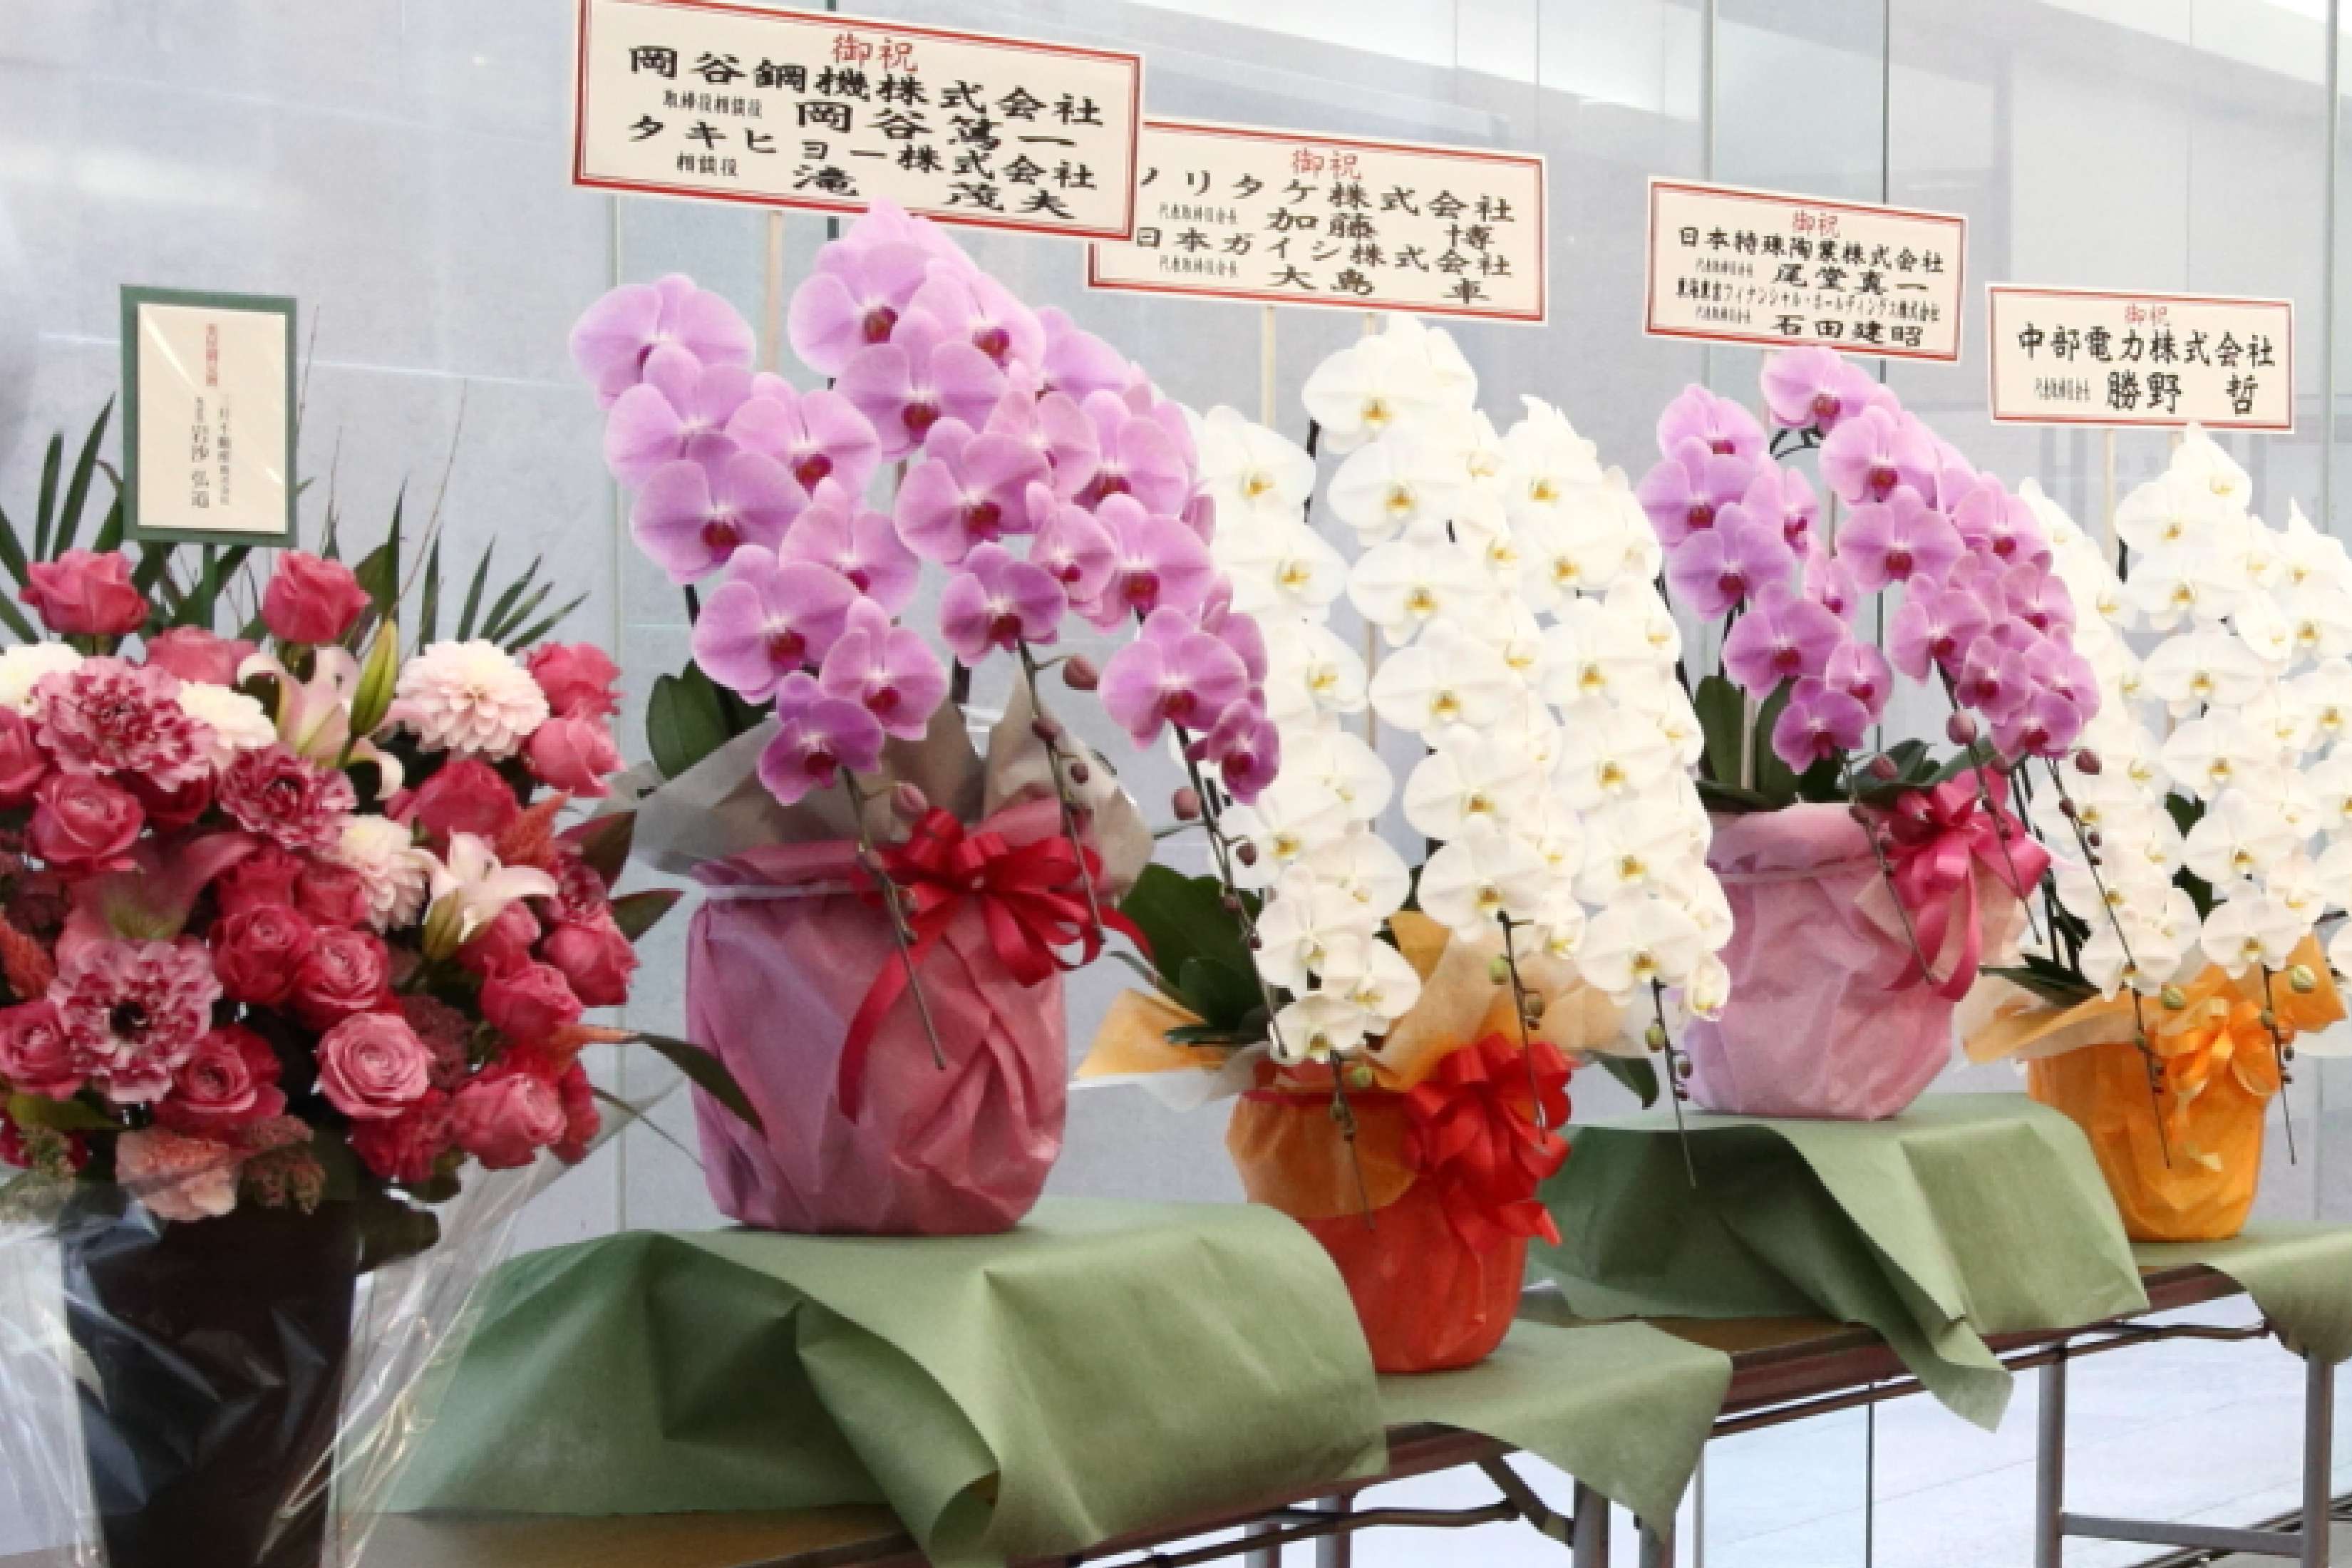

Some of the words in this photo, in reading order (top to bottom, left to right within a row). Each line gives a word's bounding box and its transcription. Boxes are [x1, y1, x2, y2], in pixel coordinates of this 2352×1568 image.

[832, 33, 918, 73] 御祝
[630, 45, 1104, 126] 岡谷鋼機株式会社
[796, 100, 1077, 149] 岡谷篤一
[1291, 148, 1361, 180] 御祝
[1140, 167, 1515, 222] ノリタケ株式会社
[1267, 207, 1378, 239] 加藤
[1792, 210, 1841, 238] 御祝
[1136, 227, 1513, 278] 日本ガイシ株式会社
[1678, 227, 1944, 274] 日本特殊陶業株式会社
[1269, 267, 1374, 296] 大島
[1770, 315, 1924, 347] 石田建昭
[2017, 321, 2276, 369] 中部電力株式会社
[2105, 369, 2183, 415] 勝野
